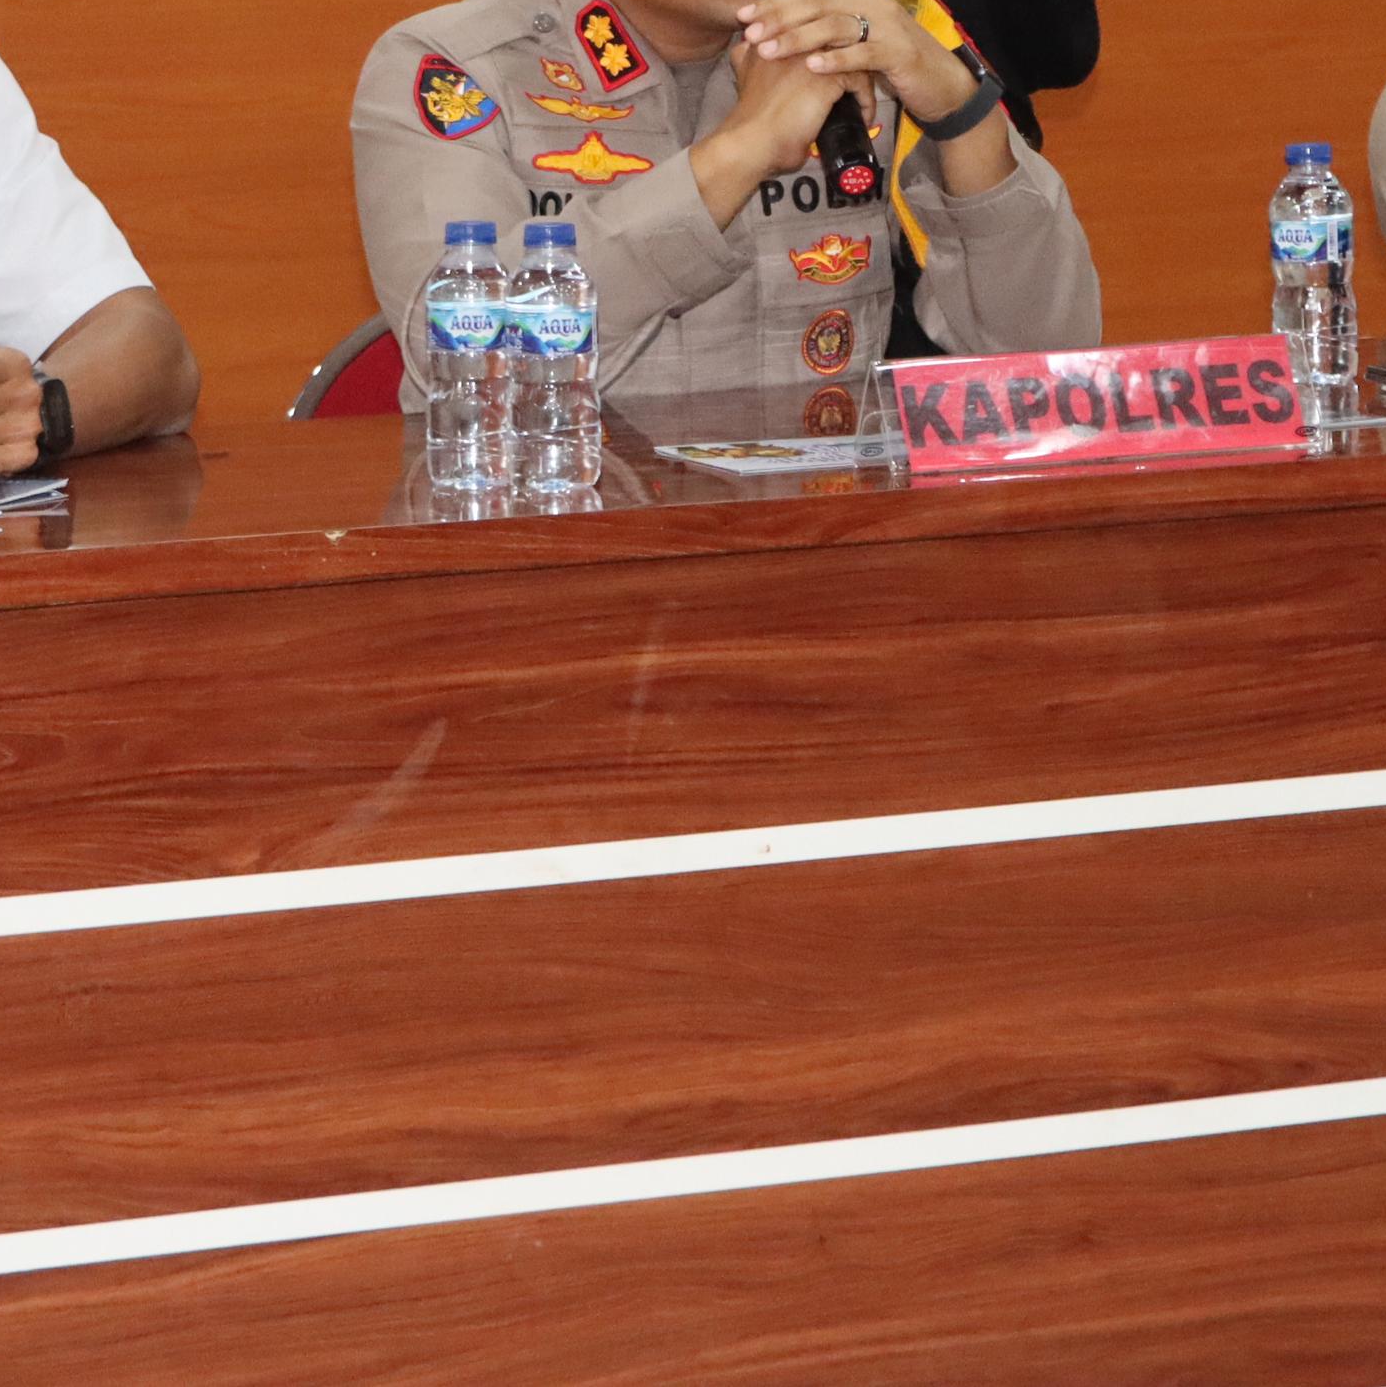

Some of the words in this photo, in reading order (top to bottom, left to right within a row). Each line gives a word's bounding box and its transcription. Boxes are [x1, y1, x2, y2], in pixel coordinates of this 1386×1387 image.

[1277, 228, 1313, 246] AQUA
[450, 314, 494, 334] AQUA
[538, 318, 582, 337] AQUA
[901, 358, 1296, 448] KAPOLRES
